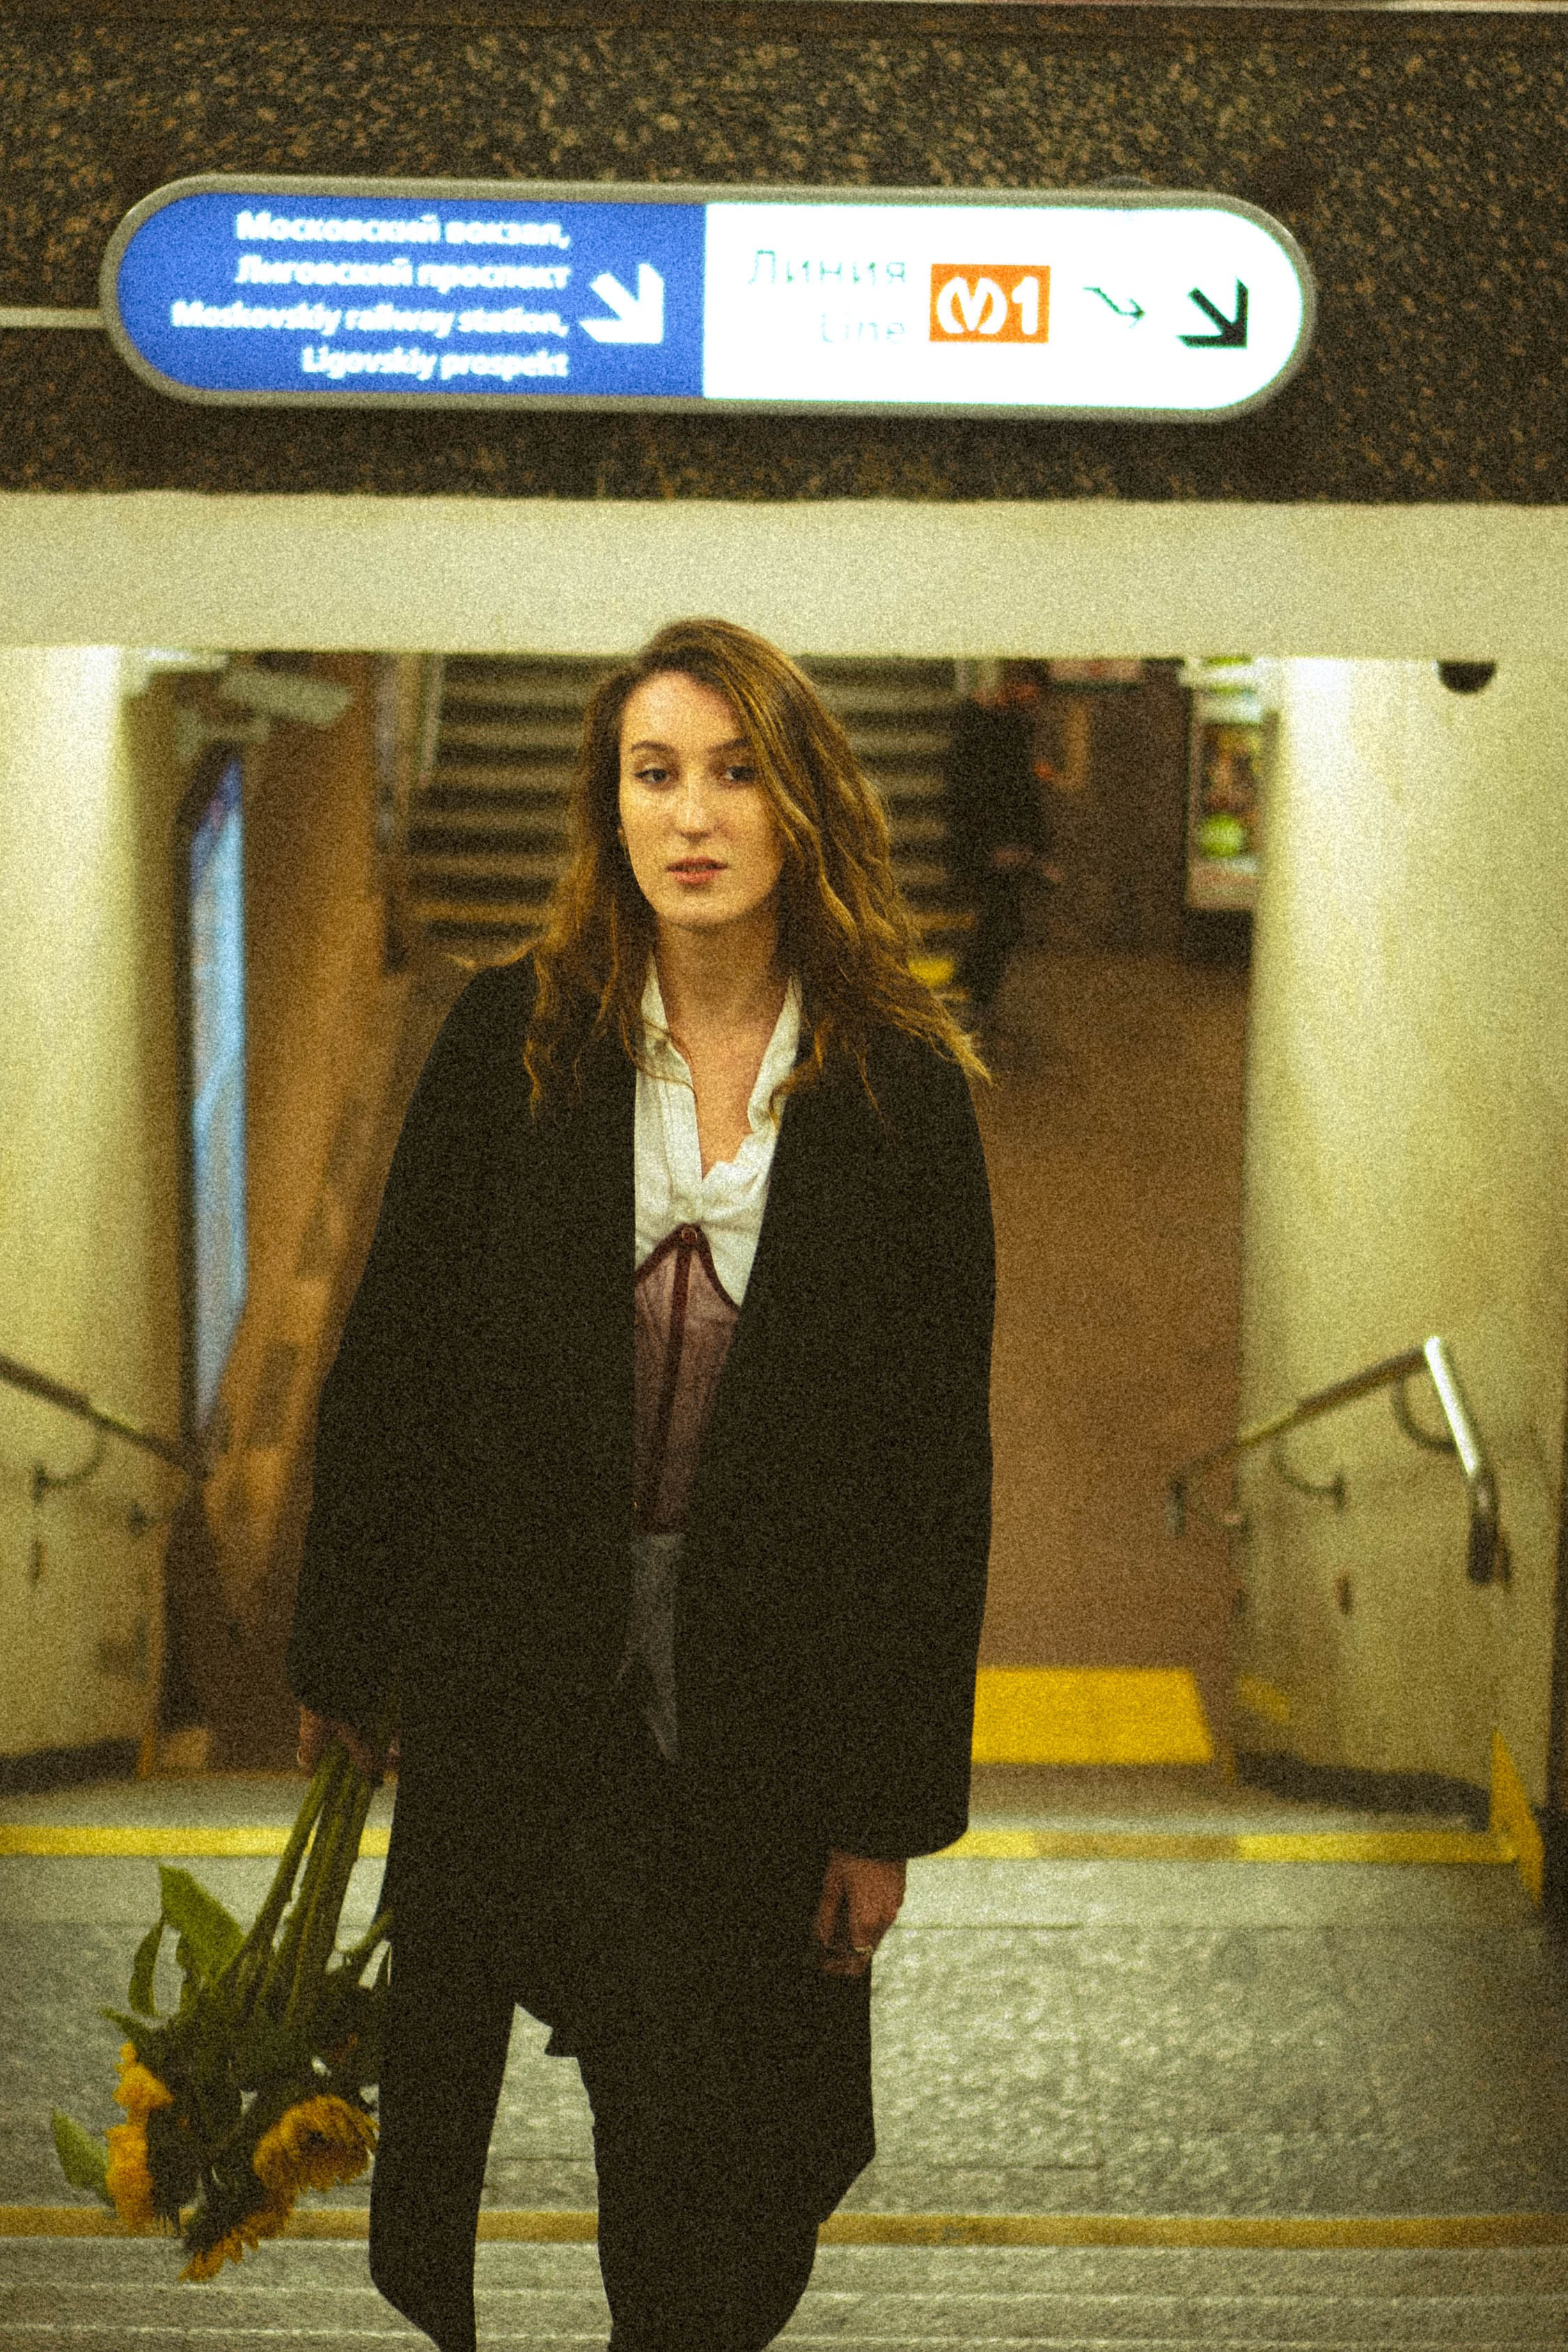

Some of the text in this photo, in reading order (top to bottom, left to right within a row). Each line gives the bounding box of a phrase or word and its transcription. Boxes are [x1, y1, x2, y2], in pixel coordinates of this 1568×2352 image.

[235, 212, 441, 244] Московский
[235, 255, 571, 295] Лиговский проспект
[748, 248, 907, 285] Линия
[345, 304, 454, 339] railway
[820, 312, 907, 345] Line
[440, 352, 569, 383] prospekt
